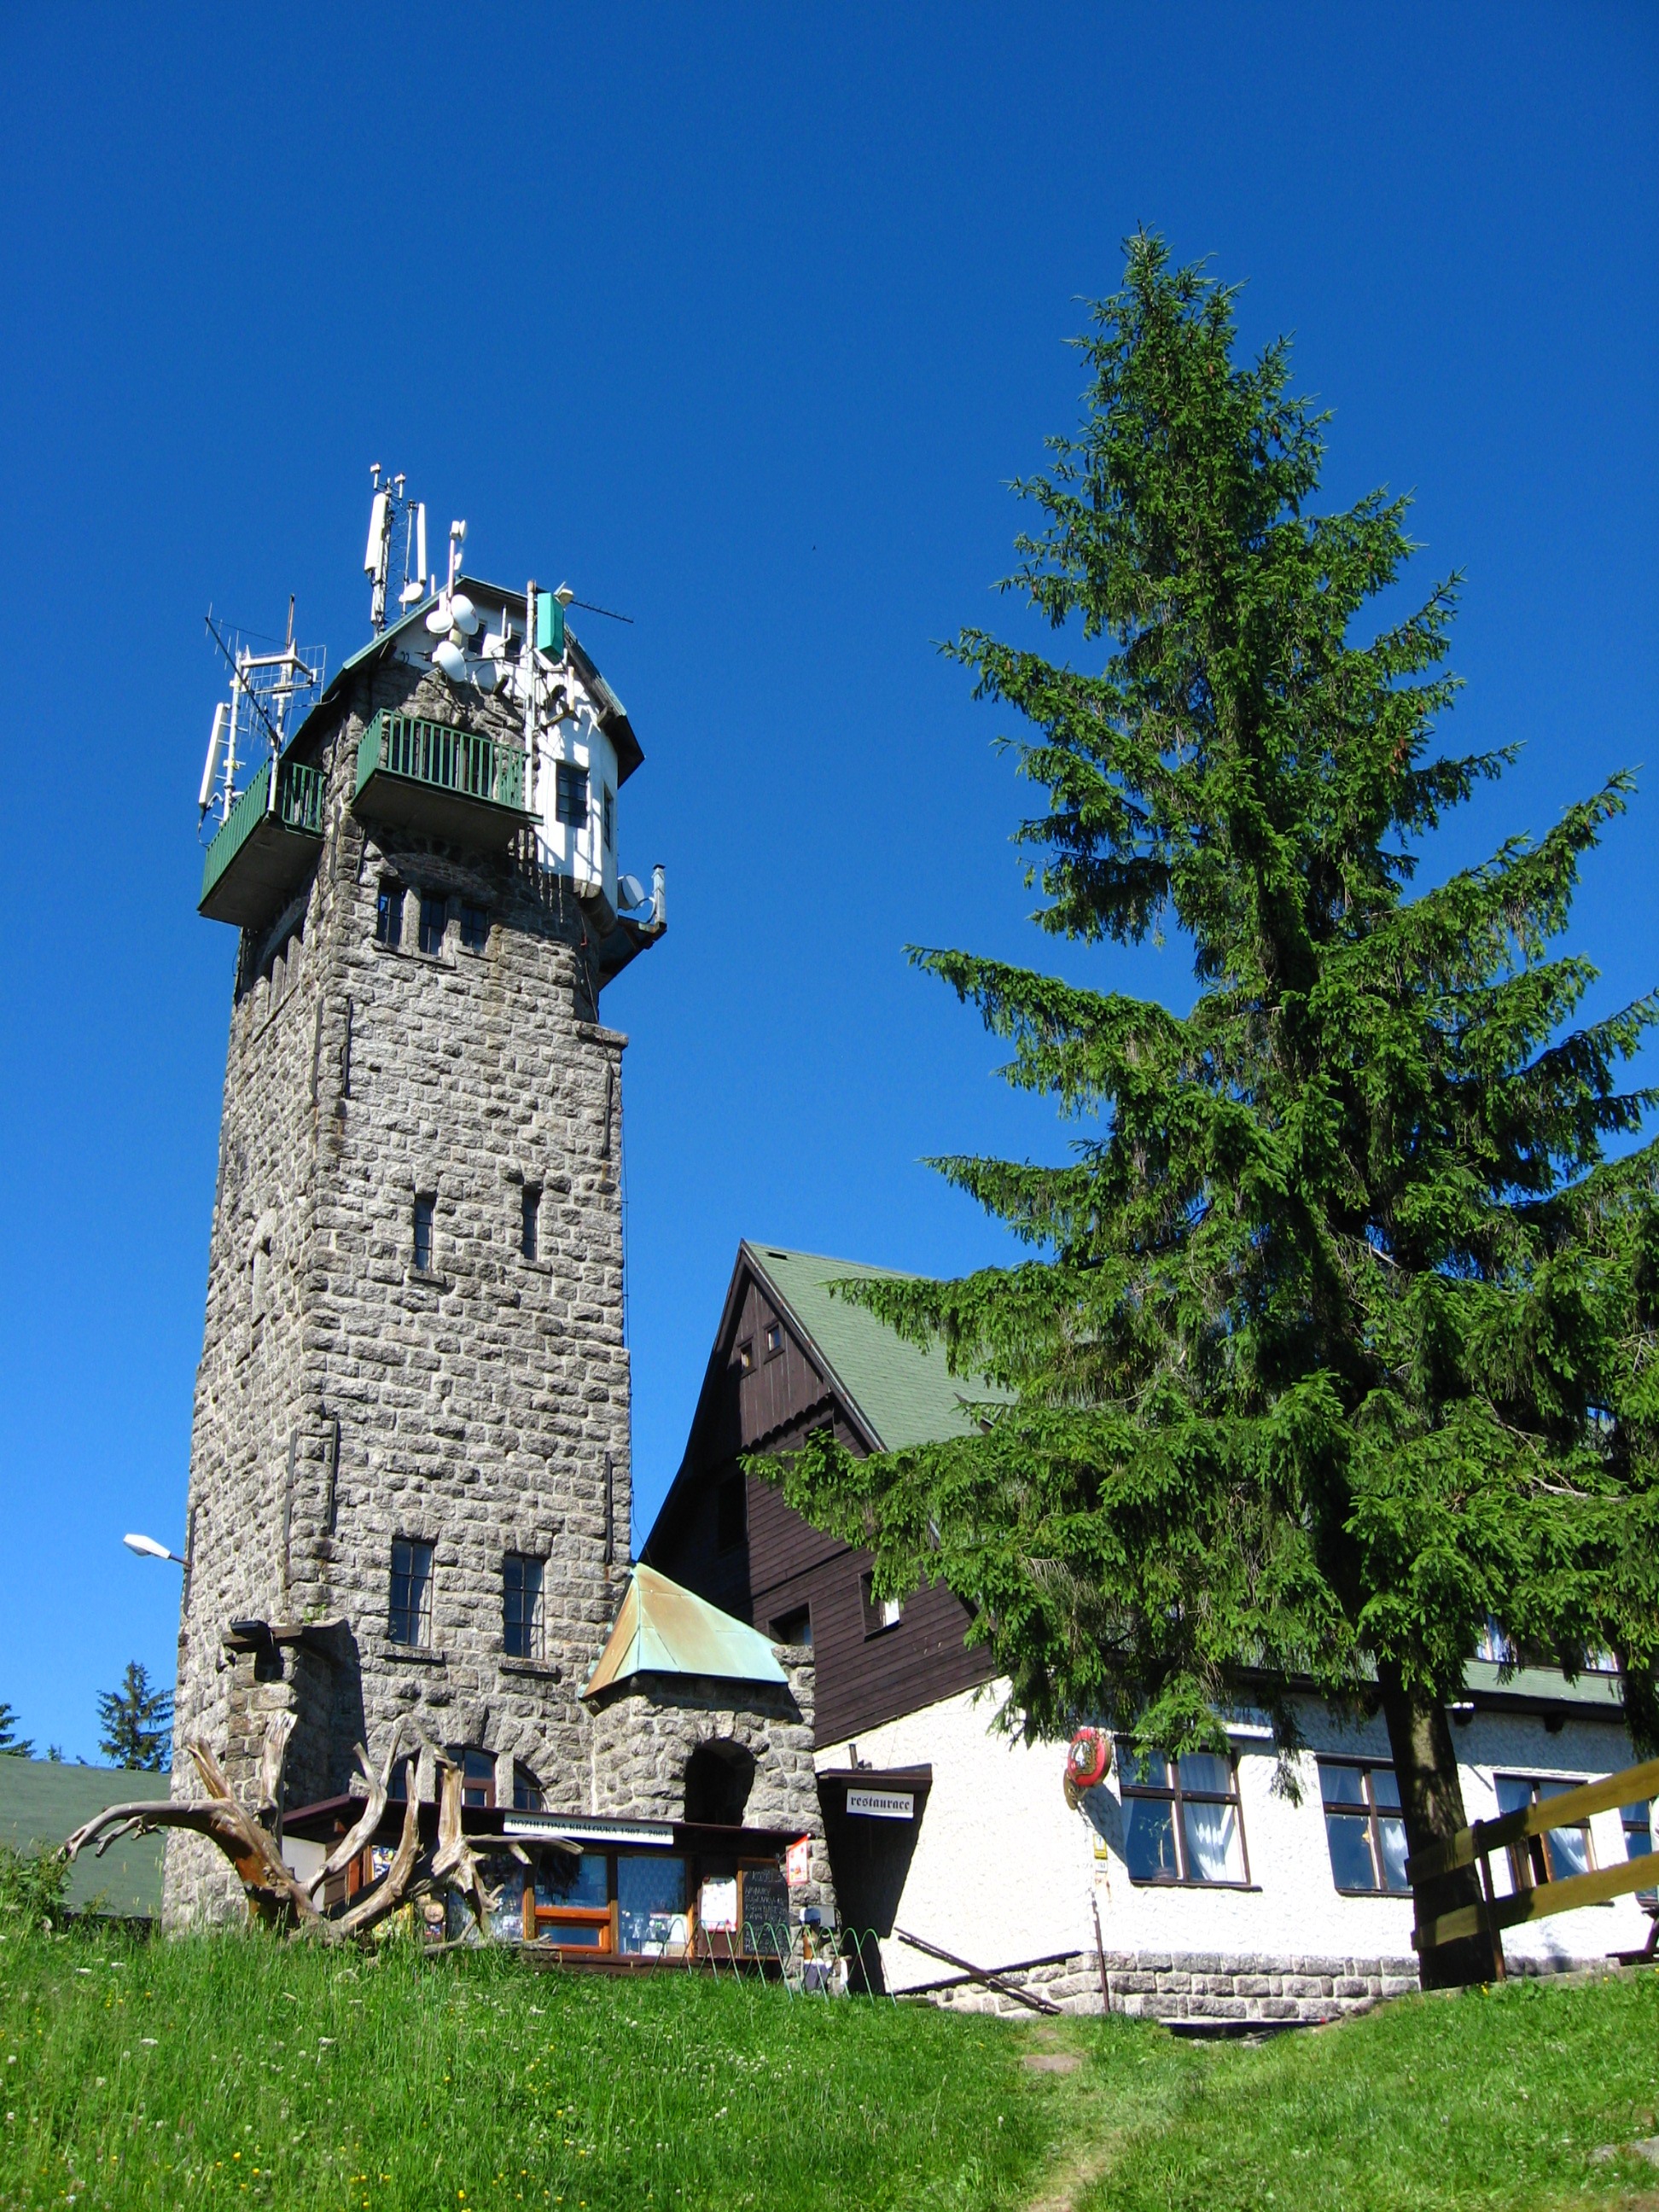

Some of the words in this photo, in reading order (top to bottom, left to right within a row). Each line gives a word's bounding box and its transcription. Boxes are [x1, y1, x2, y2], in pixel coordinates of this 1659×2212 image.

[850, 1796, 911, 1810] restaurace
[510, 1819, 567, 1831] ROZHLEDNA
[569, 1821, 617, 1833] KRÁLOVKA
[620, 1827, 641, 1836] 1907
[648, 1829, 668, 1837] 2007
